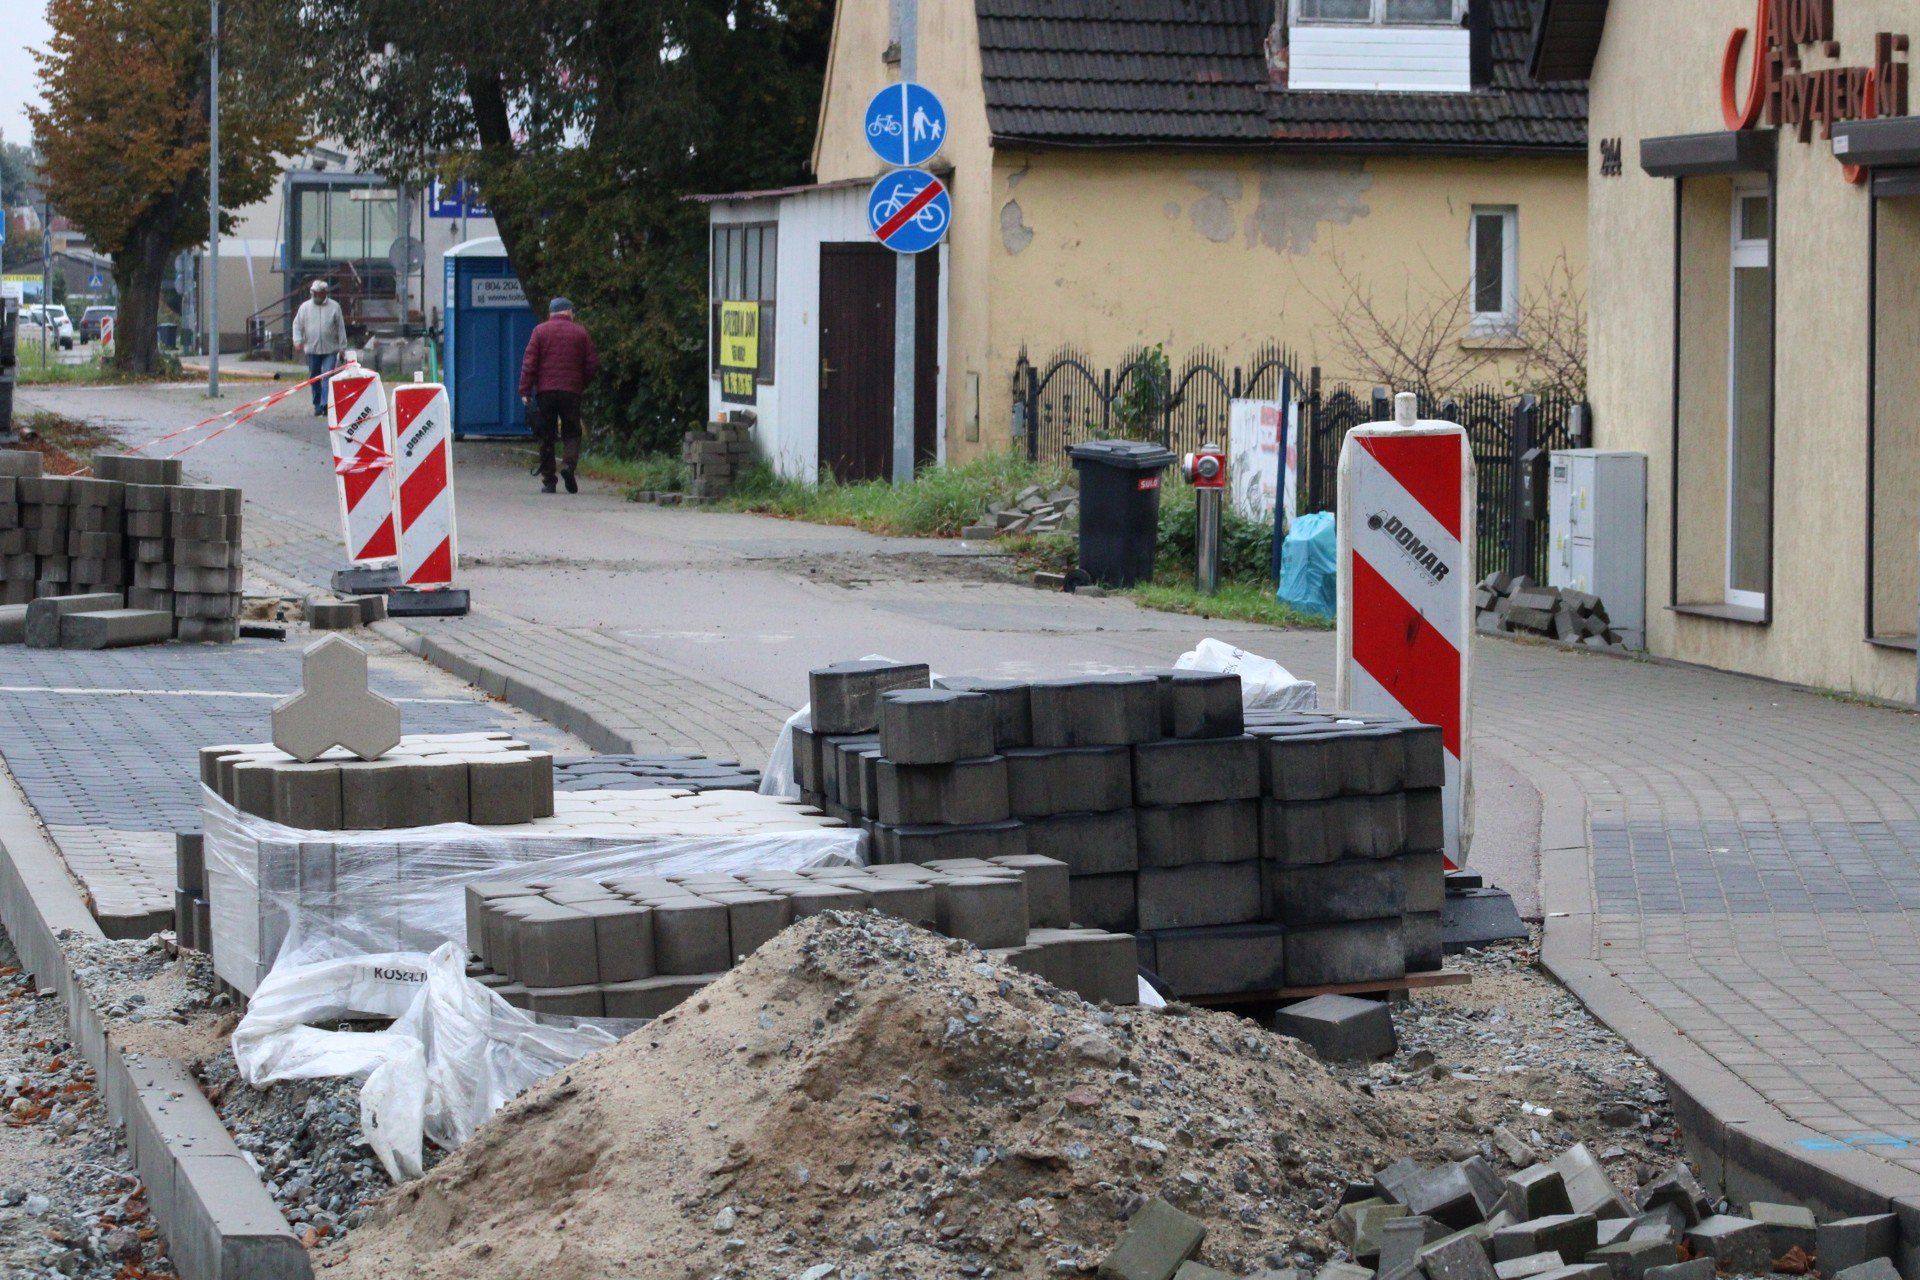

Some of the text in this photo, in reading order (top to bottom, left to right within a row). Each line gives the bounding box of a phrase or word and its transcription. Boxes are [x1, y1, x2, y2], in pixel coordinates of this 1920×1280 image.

[347, 406, 371, 436] DOMAR
[406, 420, 434, 450] DOMAR
[1383, 516, 1450, 582] DOMAR
